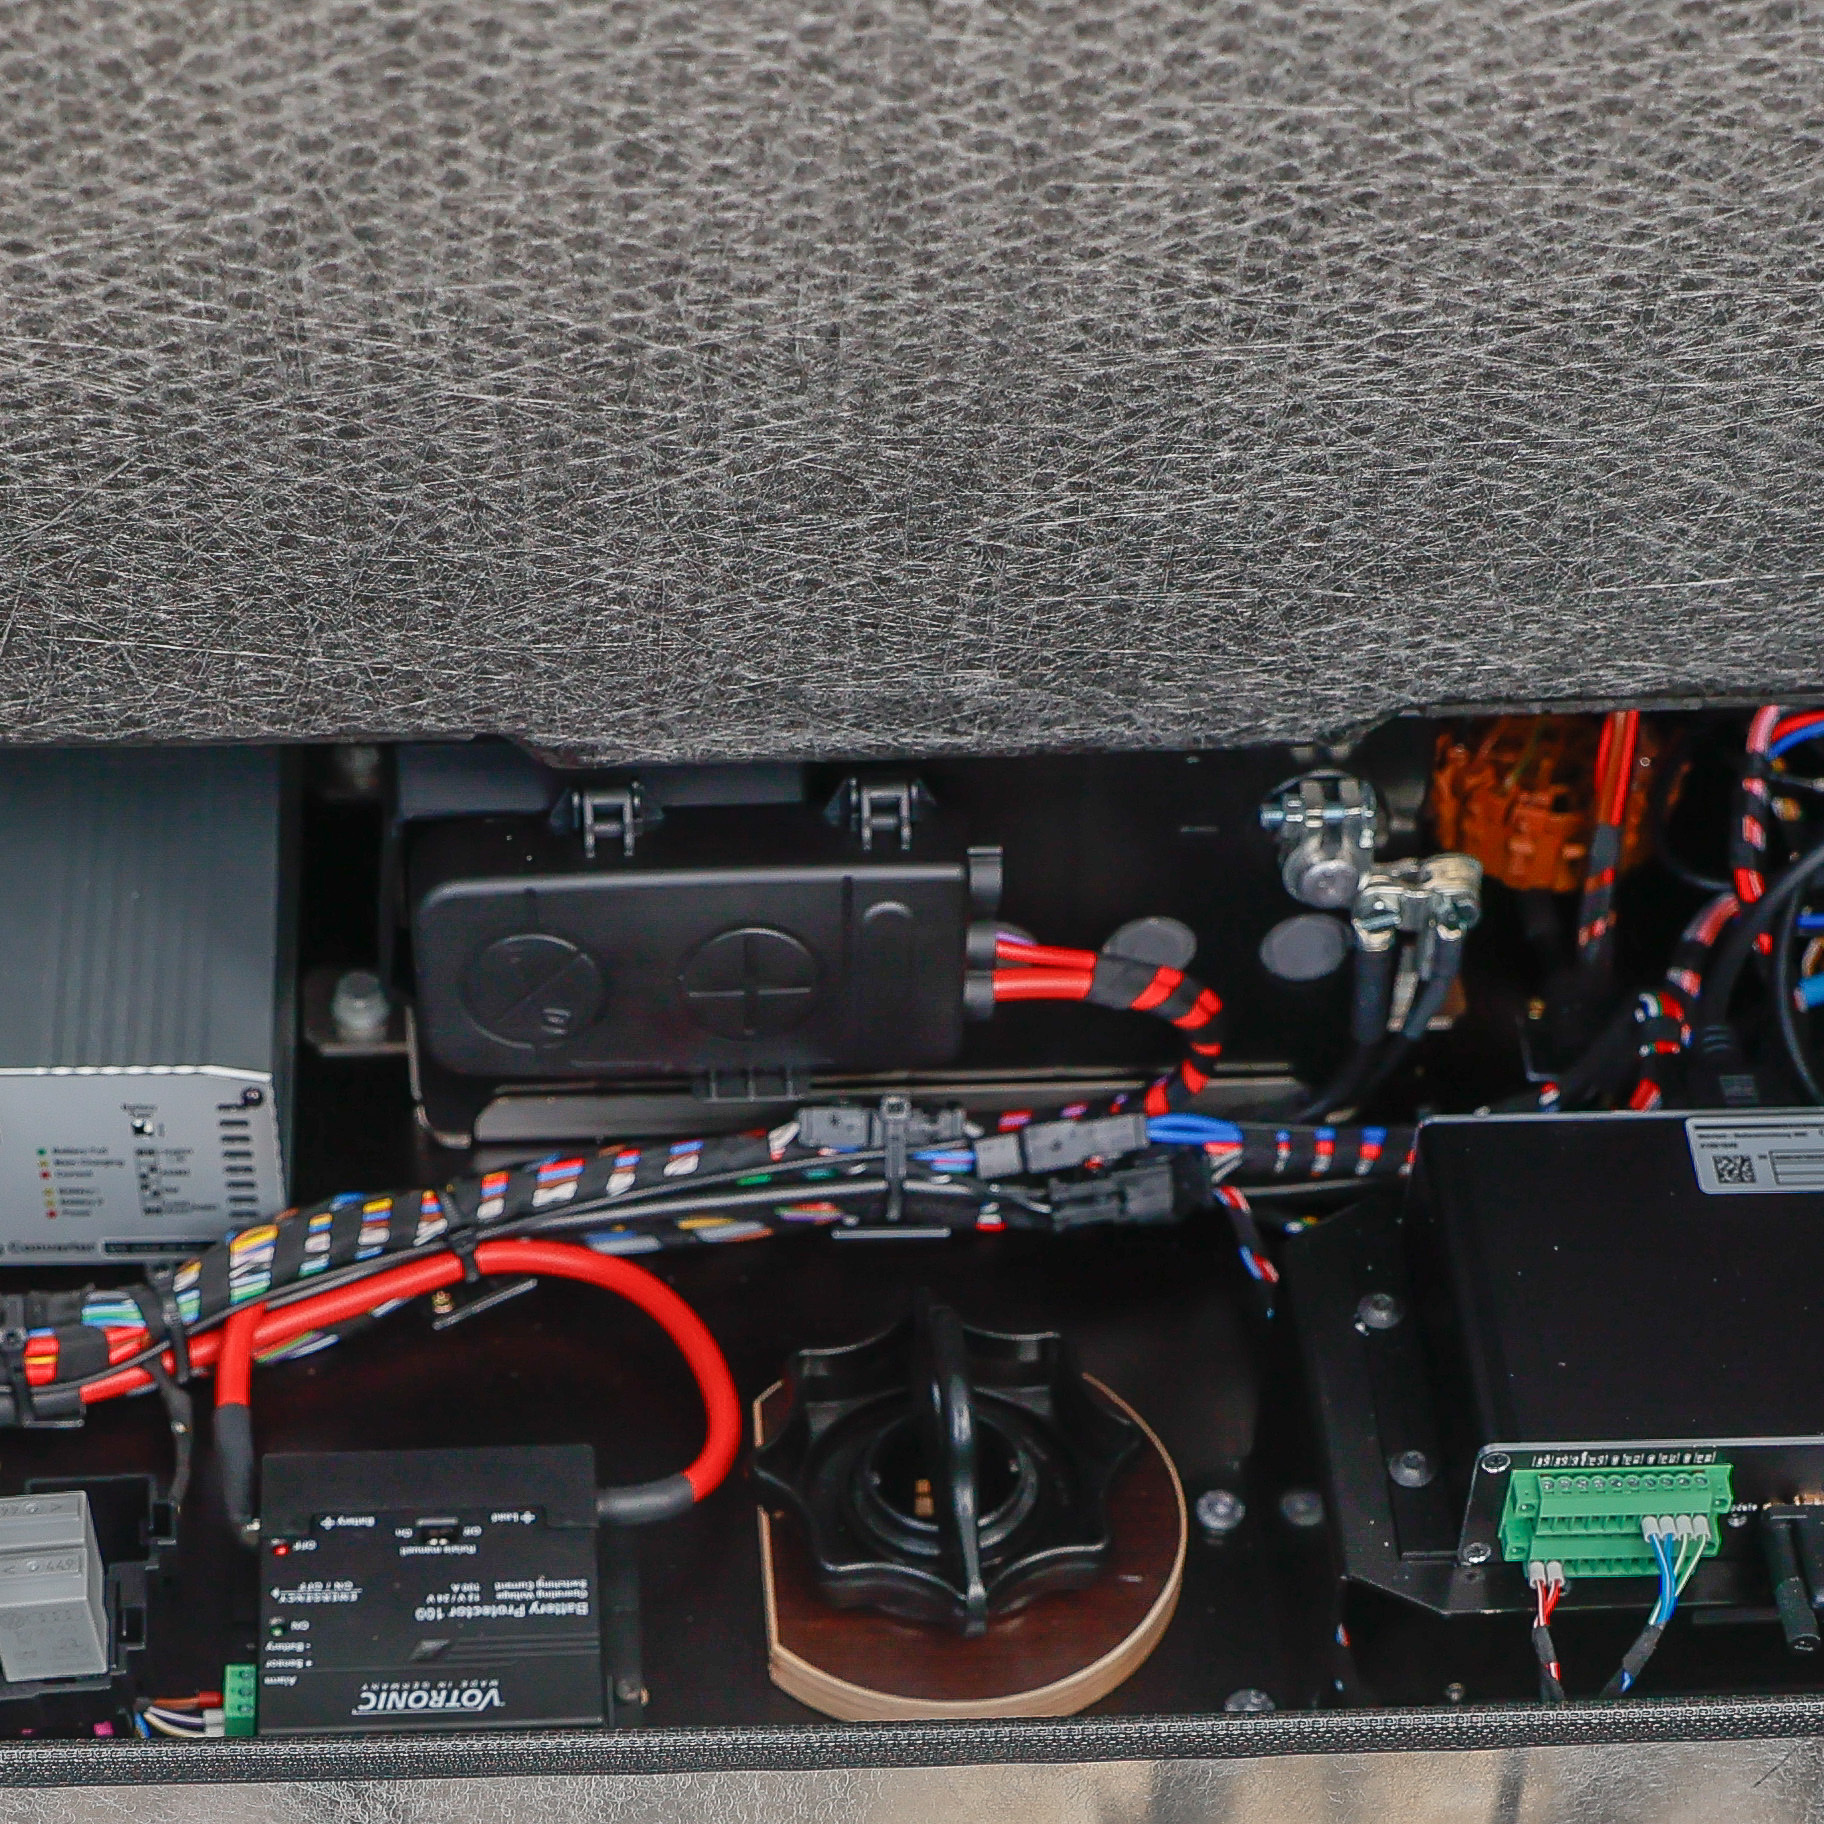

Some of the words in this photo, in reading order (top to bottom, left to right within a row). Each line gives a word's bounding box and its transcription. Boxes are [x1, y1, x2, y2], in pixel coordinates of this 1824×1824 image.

[448, 1603, 526, 1618] Protector
[529, 1601, 589, 1616] Battery
[351, 1689, 506, 1716] VOTRONIC
